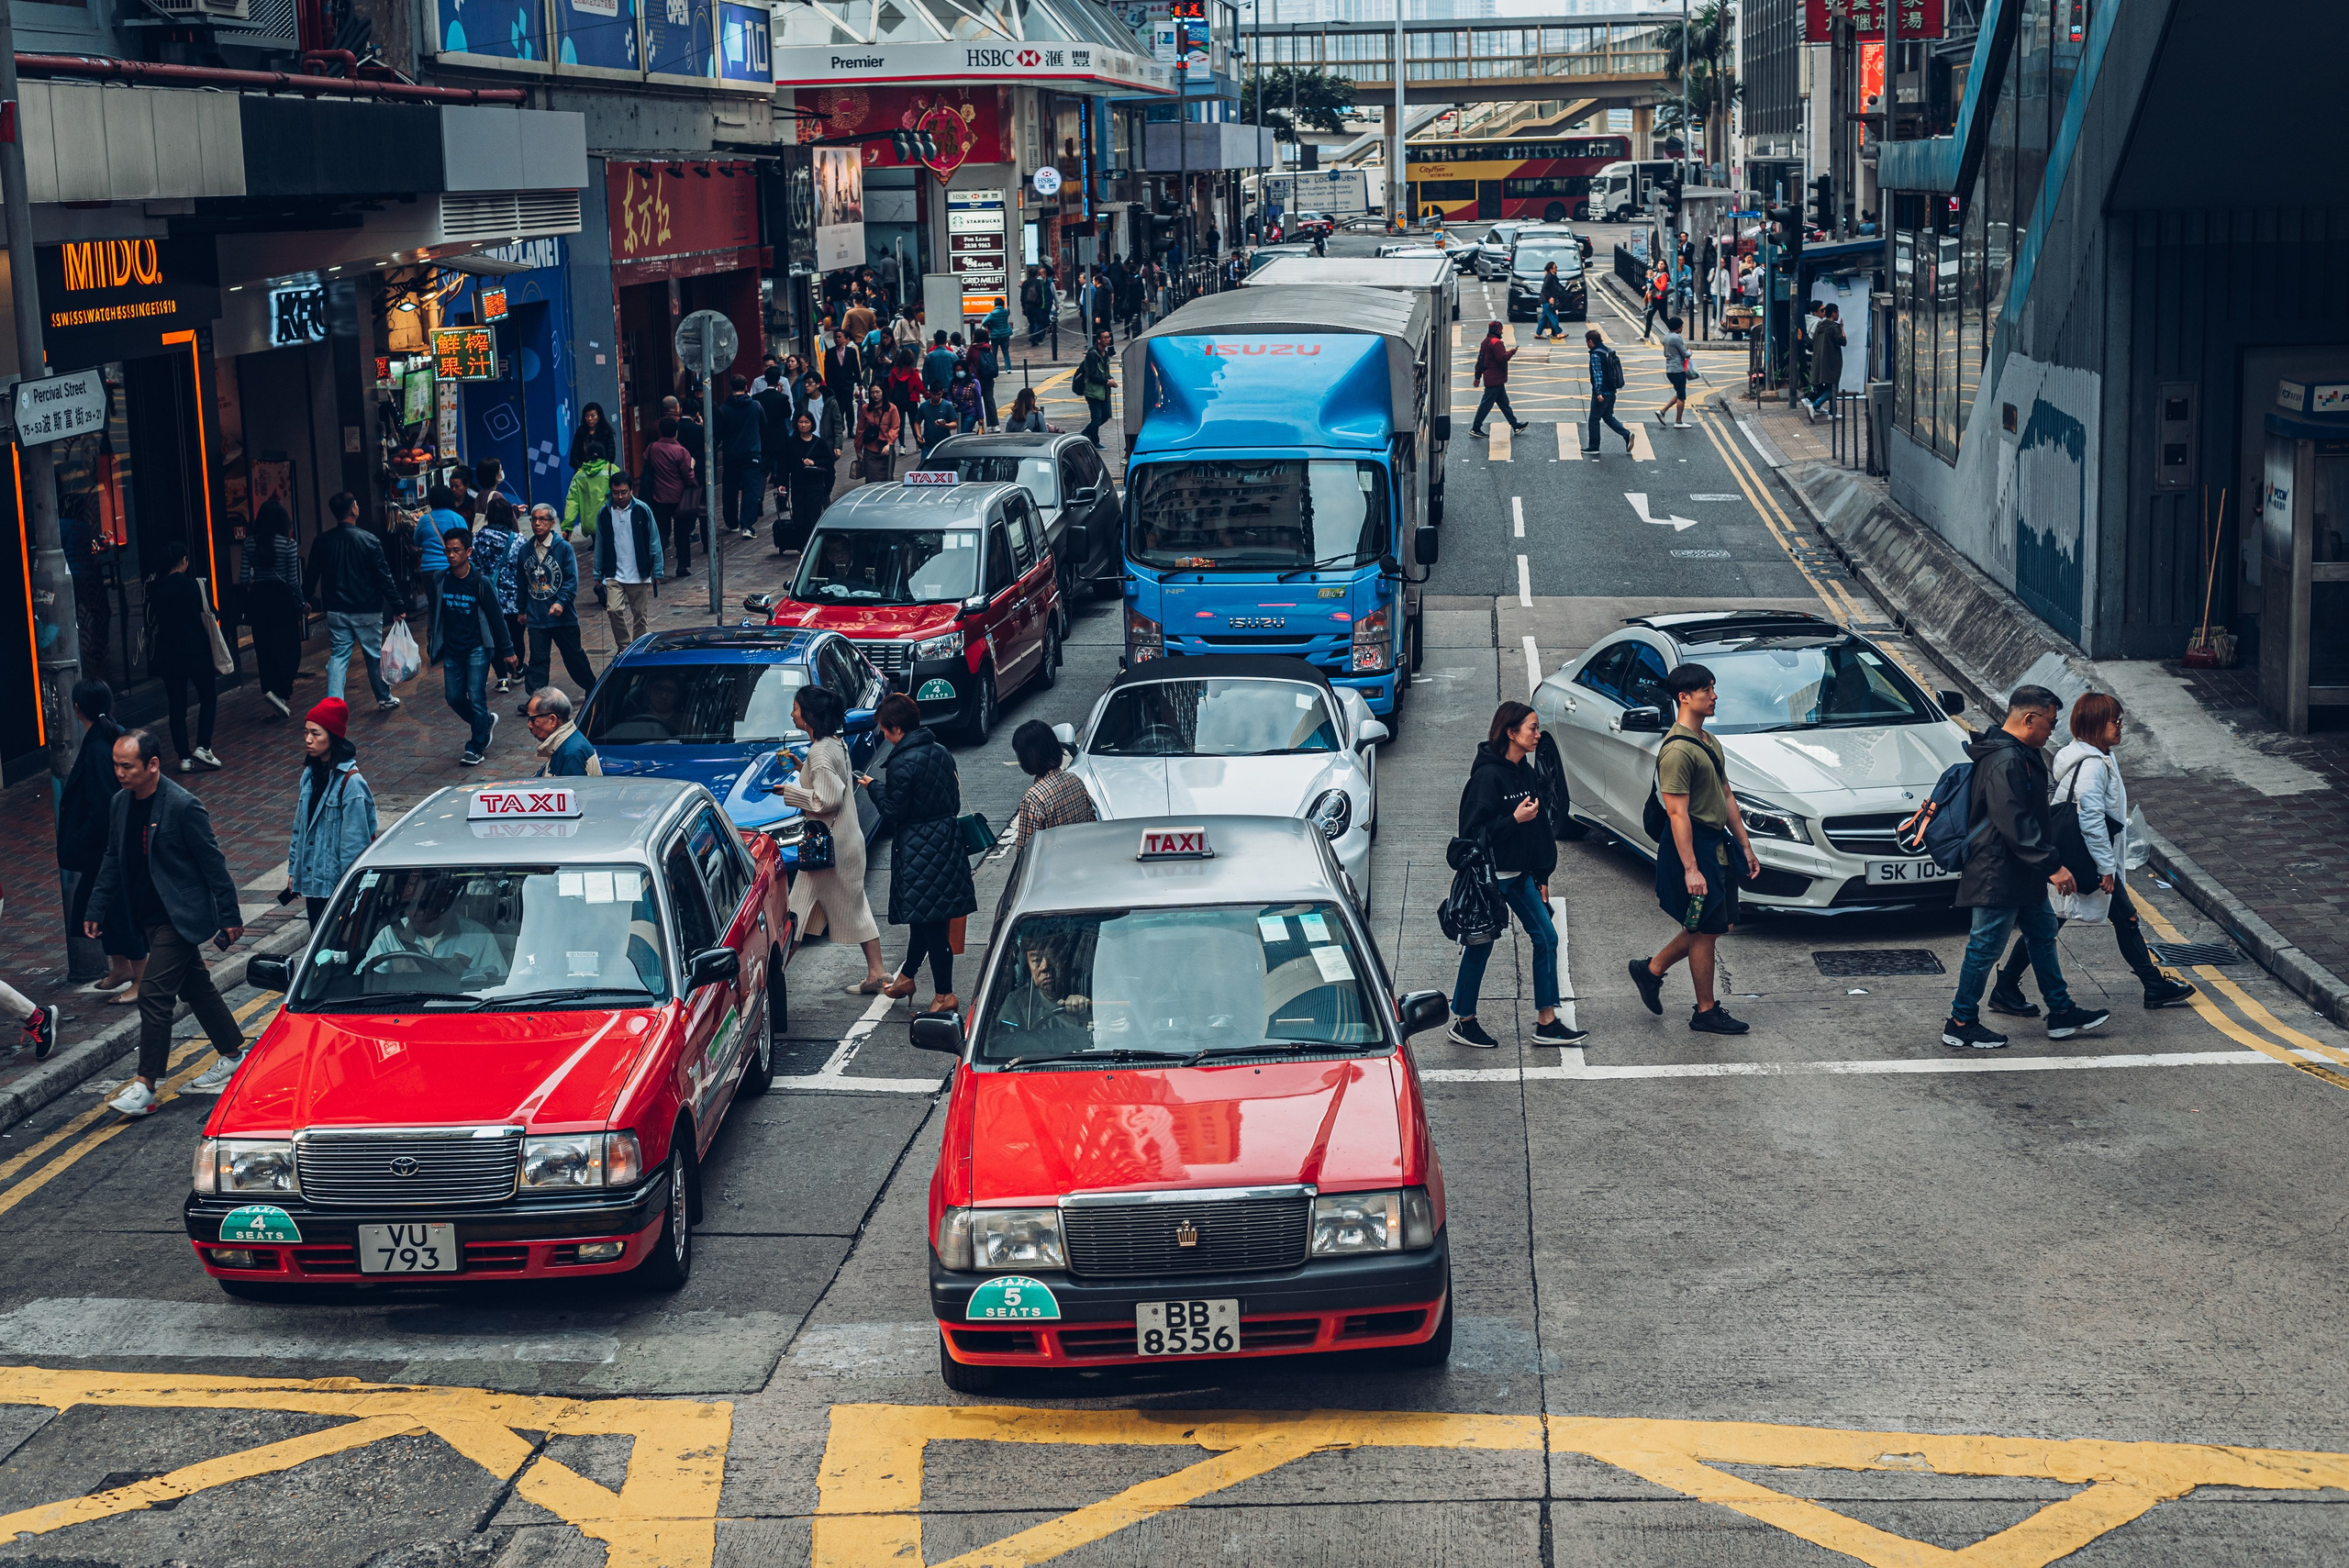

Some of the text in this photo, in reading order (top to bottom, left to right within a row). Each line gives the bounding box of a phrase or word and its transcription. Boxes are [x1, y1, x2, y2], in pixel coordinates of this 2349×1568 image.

[666, 0, 690, 26] OPEN
[745, 19, 769, 72] 入口
[830, 54, 885, 70] Premier
[965, 49, 1014, 68] HSBC
[61, 239, 158, 291] MIDO
[962, 276, 980, 284] GRID
[971, 299, 996, 307] manning
[275, 286, 331, 343] KFC
[436, 332, 490, 355] 鮮榨
[1204, 344, 1322, 356] ISUZU
[439, 354, 492, 378] 果汁
[33, 379, 87, 405] Percival Street
[42, 406, 84, 434] 波斯富街
[908, 473, 953, 484] TAXI
[2274, 487, 2288, 501] PCCW
[462, 594, 476, 603] thing
[1229, 617, 1285, 628] ISUZU
[932, 684, 941, 694] 4
[1638, 677, 1659, 686] KFC
[479, 793, 566, 813] TAXI
[1146, 833, 1204, 852] TAXI
[1880, 863, 1908, 881] SK
[243, 1206, 276, 1216] TAXI
[250, 1214, 266, 1231] 4
[236, 1230, 285, 1240] SEATS
[386, 1225, 429, 1248] VU
[377, 1247, 440, 1271] 793
[994, 1278, 1033, 1289] TAXI
[1003, 1287, 1022, 1307] 5
[985, 1307, 1041, 1318] SEATS
[1165, 1301, 1210, 1329] BB
[1143, 1326, 1235, 1355] 8556
